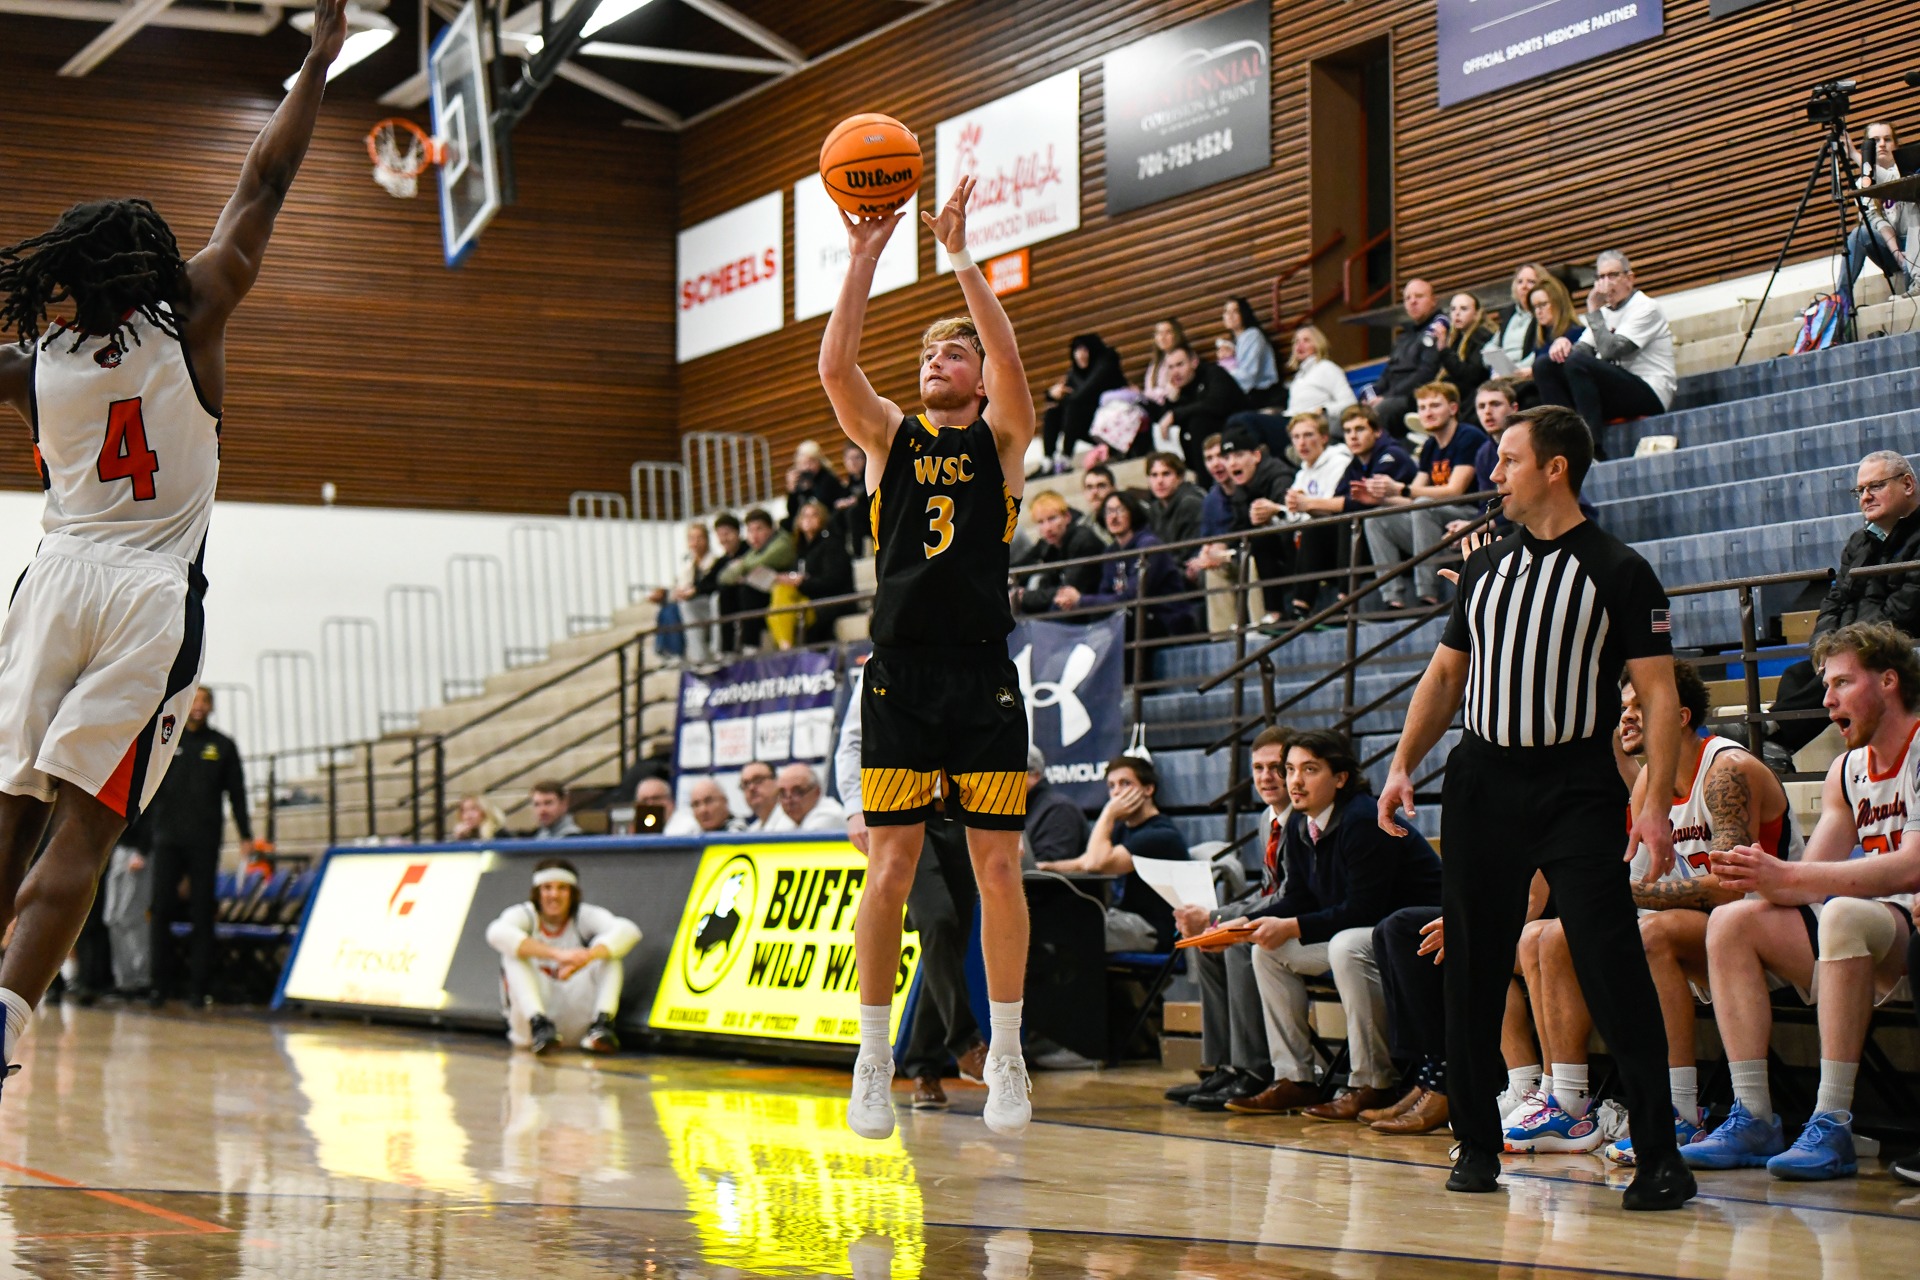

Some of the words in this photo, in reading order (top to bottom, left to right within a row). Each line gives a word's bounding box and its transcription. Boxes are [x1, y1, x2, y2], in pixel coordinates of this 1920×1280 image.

[1463, 49, 1505, 75] OFFICIAL
[1506, 36, 1543, 60] SPORTS
[1544, 20, 1590, 47] MEDICINE
[1591, 4, 1638, 31] PARTNER
[845, 167, 913, 189] Wilson
[680, 249, 776, 311] SCHEELS
[97, 396, 159, 501] 4
[914, 453, 974, 486] WSC
[923, 495, 954, 560] 3
[748, 943, 816, 988] WILD
[823, 943, 915, 995] WIS
